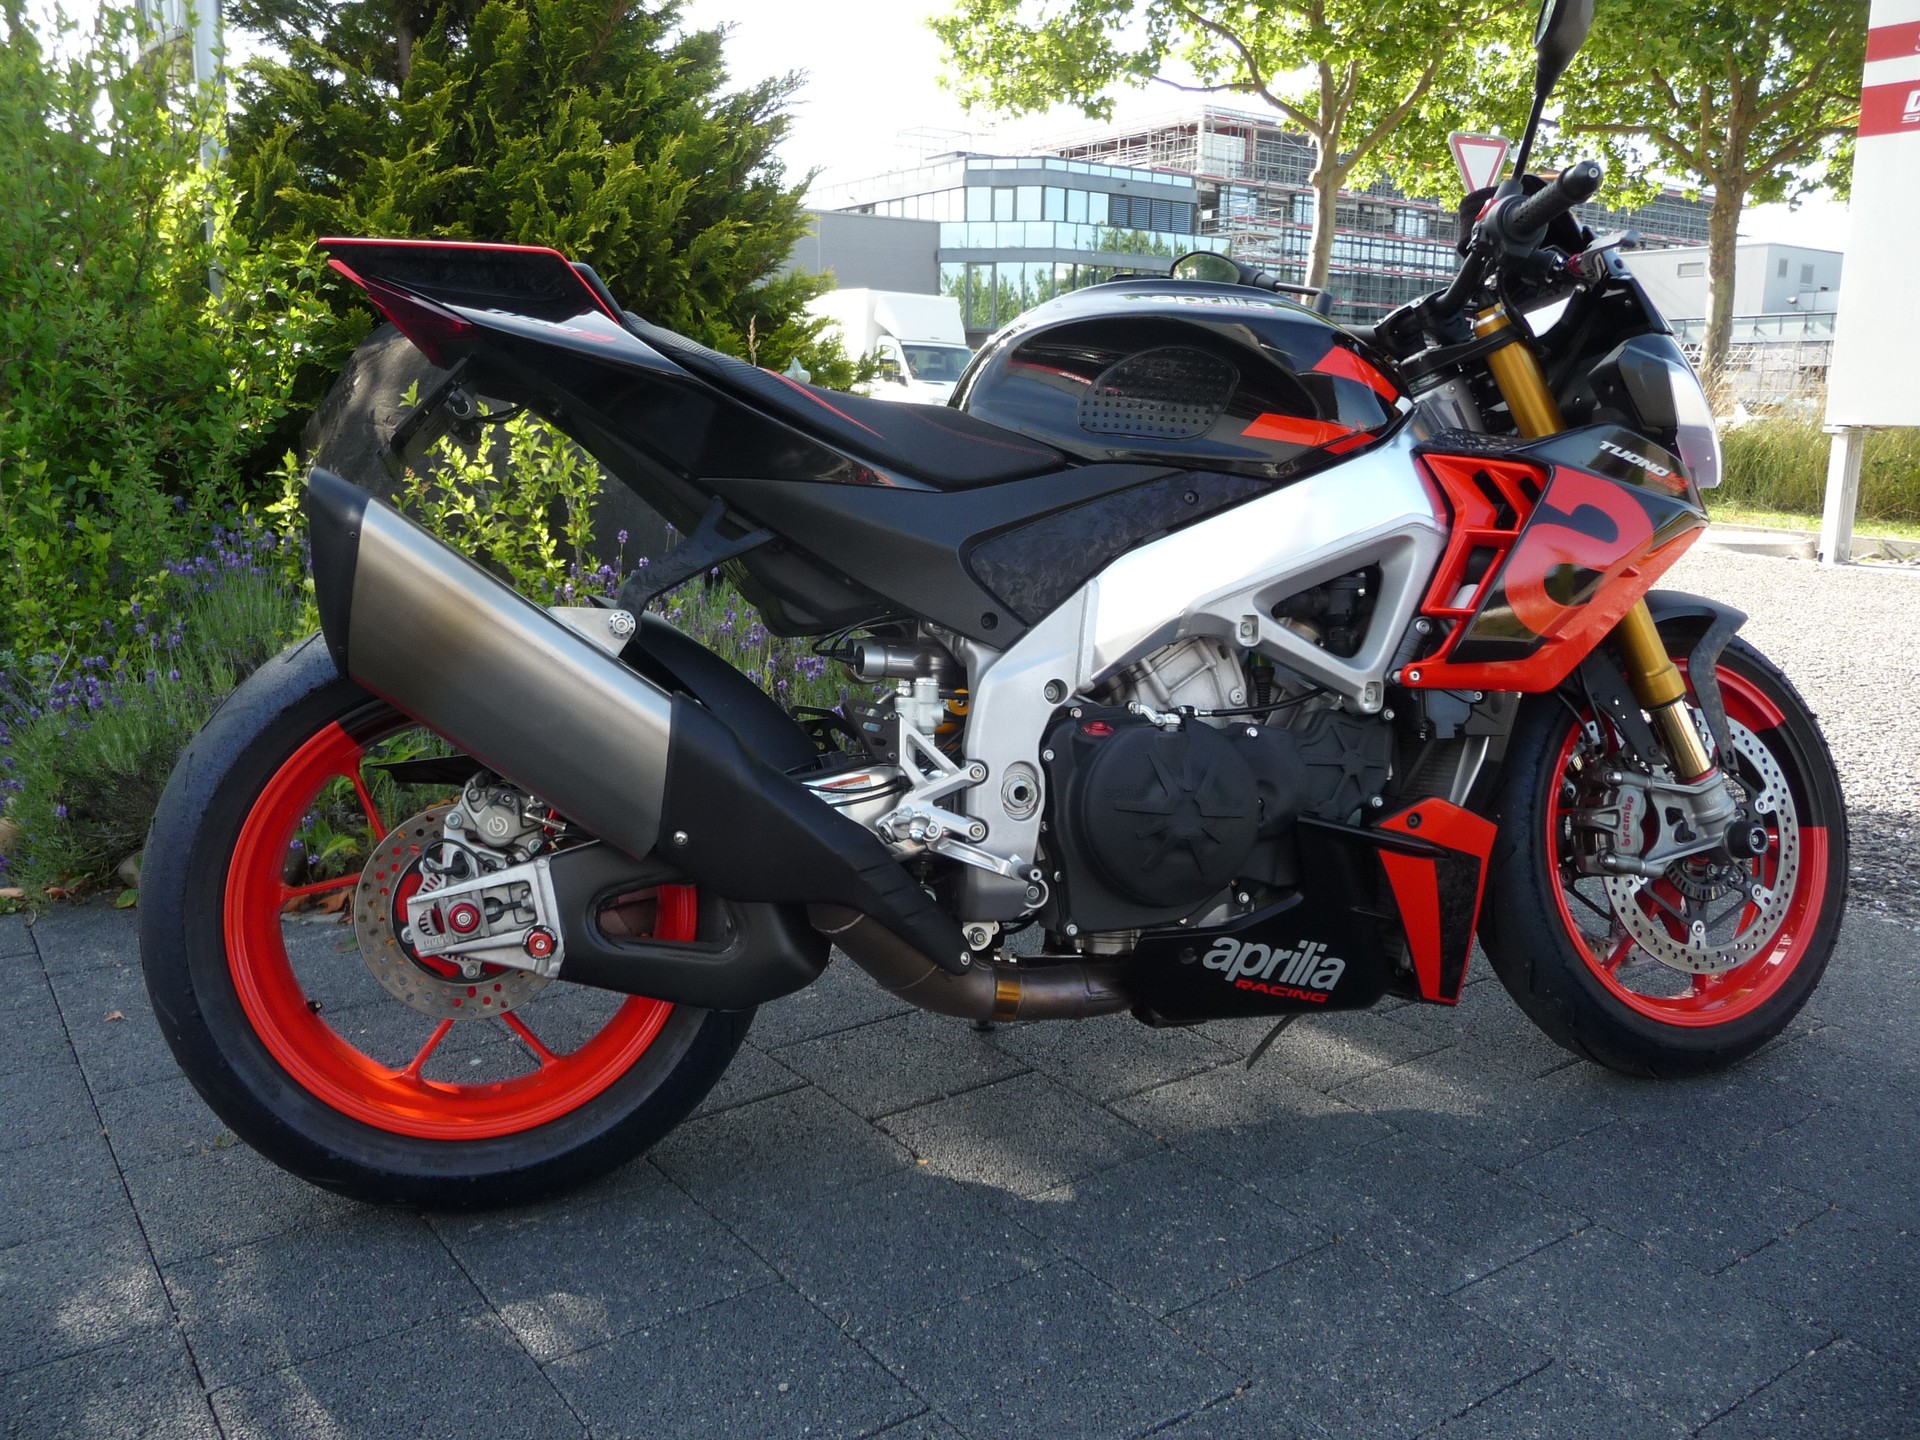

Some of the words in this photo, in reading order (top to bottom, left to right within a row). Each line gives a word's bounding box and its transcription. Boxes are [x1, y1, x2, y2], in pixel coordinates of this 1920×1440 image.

[1151, 295, 1273, 310] aprilia
[1599, 440, 1670, 477] TUONO
[1621, 796, 1634, 847] brembo
[1202, 937, 1346, 991] aprilia
[1235, 979, 1328, 1003] RACING
